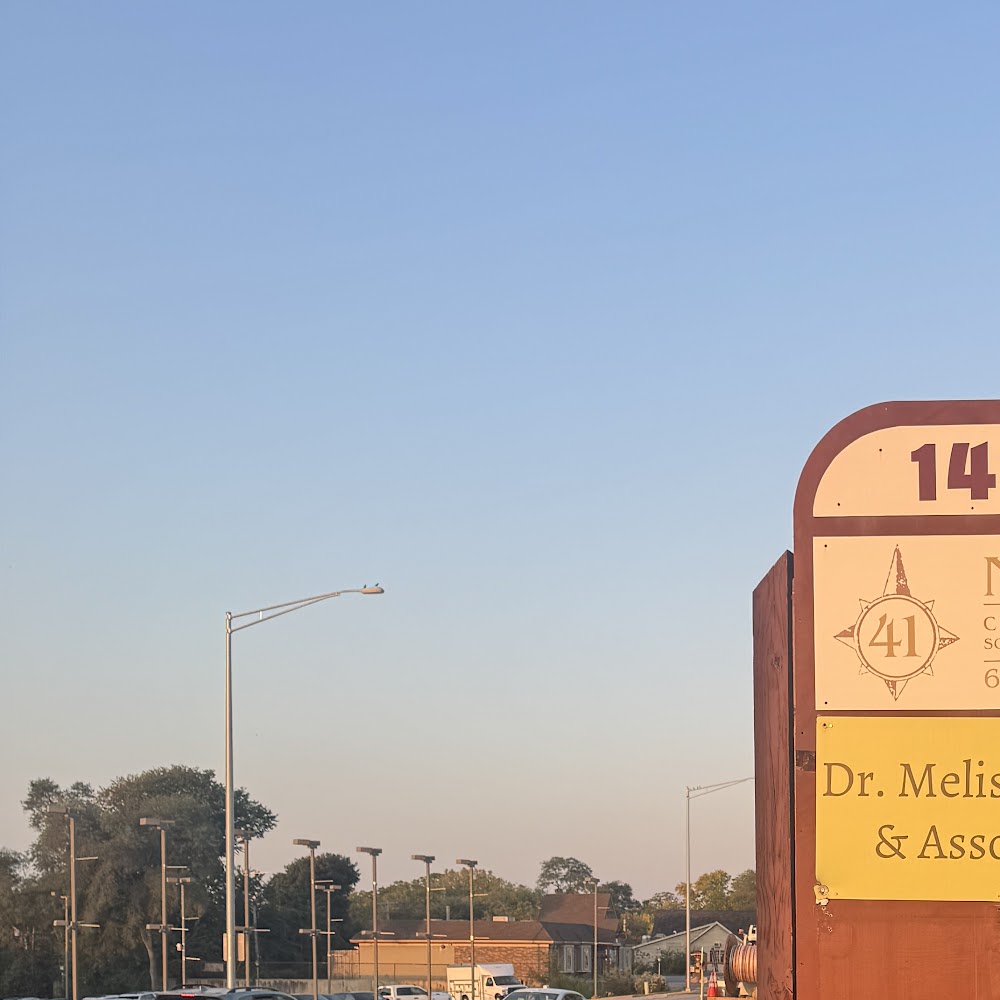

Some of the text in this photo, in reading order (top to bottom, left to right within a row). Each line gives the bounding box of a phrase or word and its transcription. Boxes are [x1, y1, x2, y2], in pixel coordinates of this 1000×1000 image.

[868, 613, 921, 657] 41
[823, 762, 885, 798] Dr.
[875, 824, 909, 860] &
